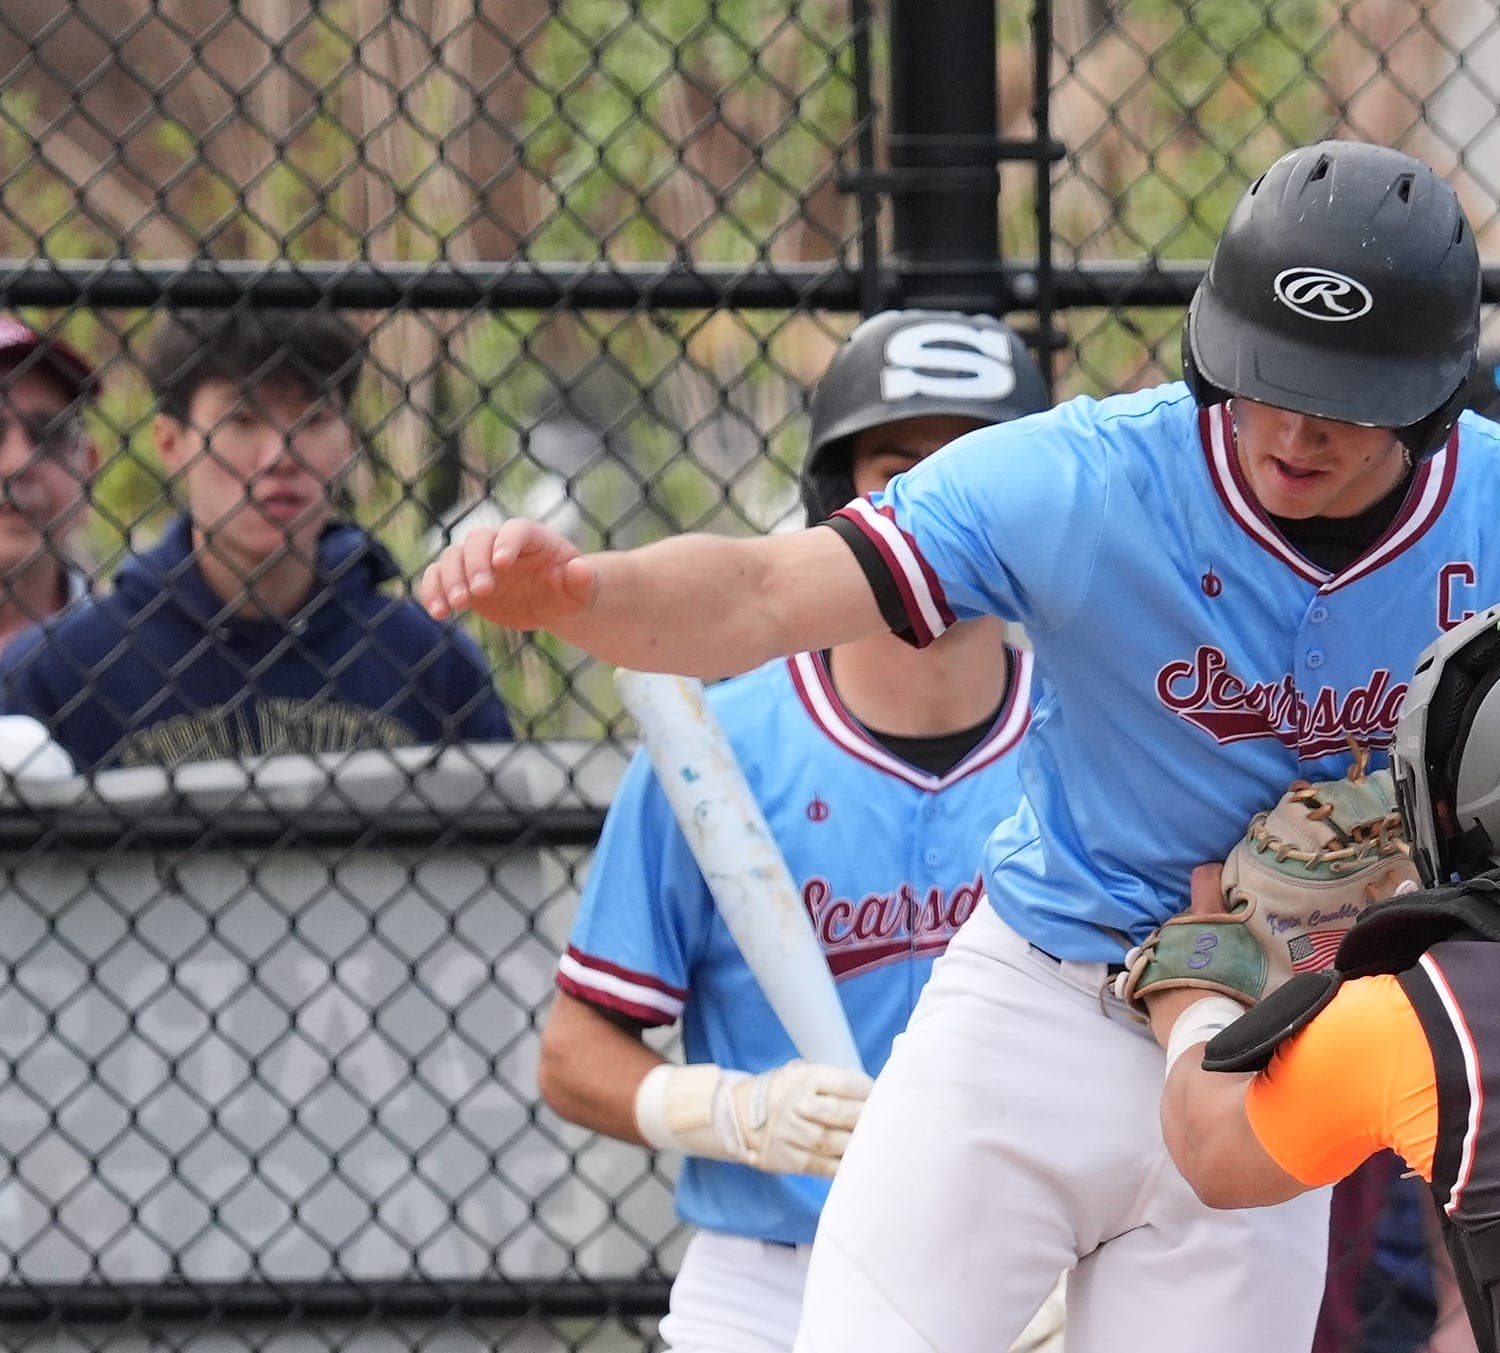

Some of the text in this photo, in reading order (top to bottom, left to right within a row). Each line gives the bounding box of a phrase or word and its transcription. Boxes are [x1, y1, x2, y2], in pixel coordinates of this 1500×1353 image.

[1283, 274, 1355, 316] R
[880, 322, 1017, 401] S
[1436, 561, 1476, 632] C
[1186, 932, 1219, 970] 3
